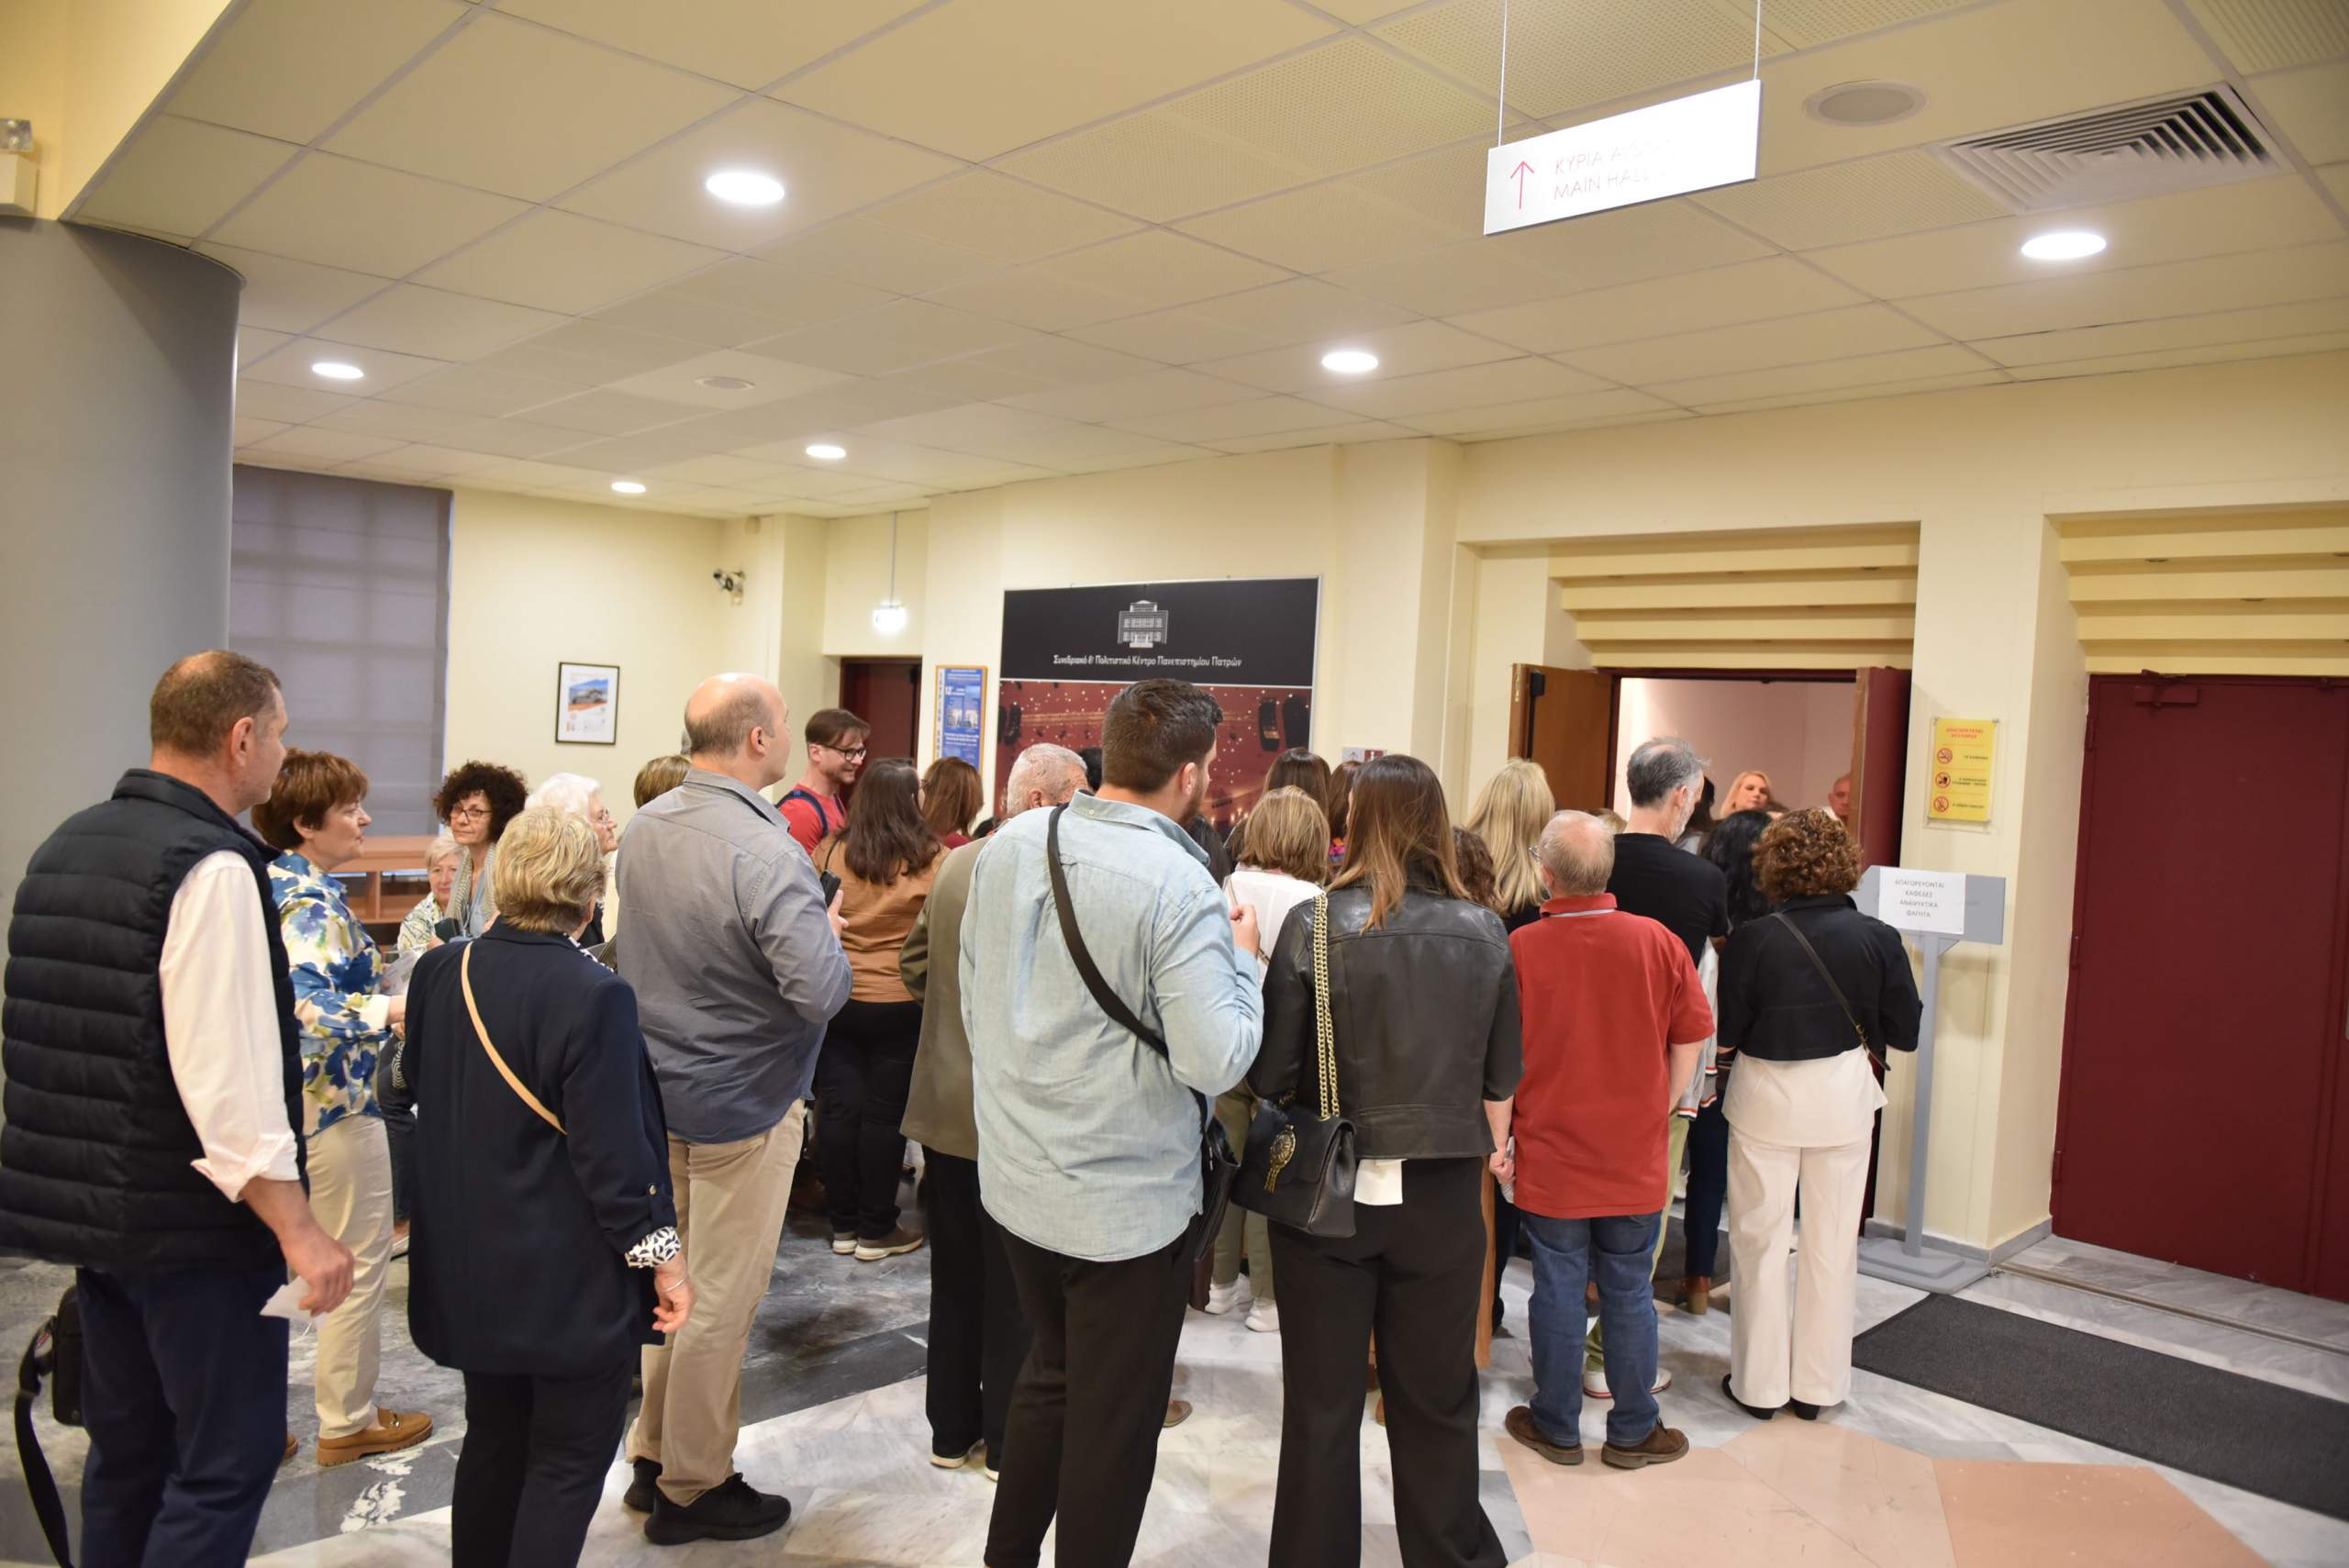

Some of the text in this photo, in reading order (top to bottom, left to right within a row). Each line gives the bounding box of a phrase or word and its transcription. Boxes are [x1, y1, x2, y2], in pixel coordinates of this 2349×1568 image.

[1553, 176, 1601, 200] MAIN
[1052, 654, 1086, 666] Συνεδριακό
[1095, 654, 1131, 665] Πολιτιστικό
[1131, 655, 1156, 668] Κέντρο
[1157, 655, 1210, 669] Πανεπιστημίου
[1211, 655, 1242, 669] Πατρών
